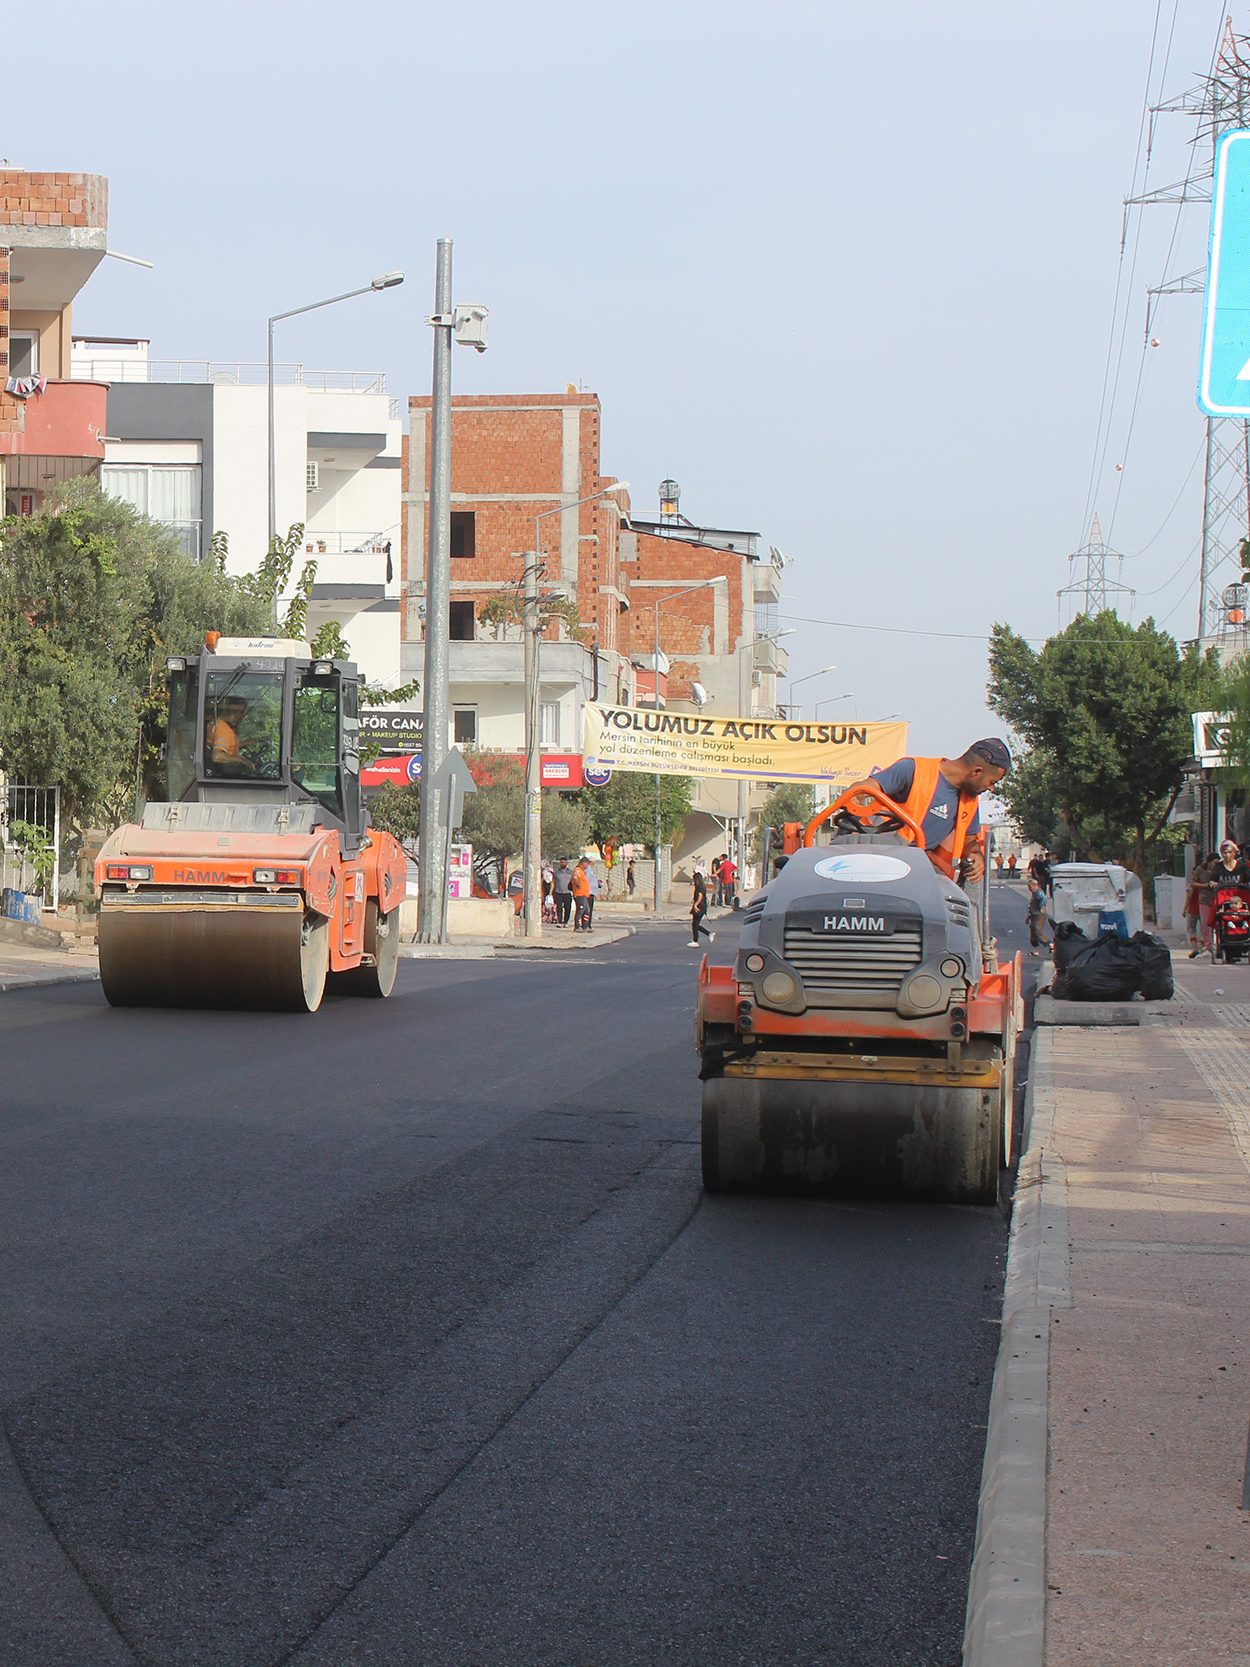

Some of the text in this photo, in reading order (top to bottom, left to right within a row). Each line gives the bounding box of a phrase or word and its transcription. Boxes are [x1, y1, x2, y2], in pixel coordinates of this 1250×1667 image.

[599, 709, 867, 745] YOLUMUZ AÇIK OLSUN
[599, 731, 735, 752] Mersin tarihinin en büyük
[599, 743, 616, 755] yol
[619, 744, 677, 758] düzenleme
[732, 753, 775, 767] başladı.
[174, 870, 226, 883] HAMM
[823, 916, 885, 931] HAMM
